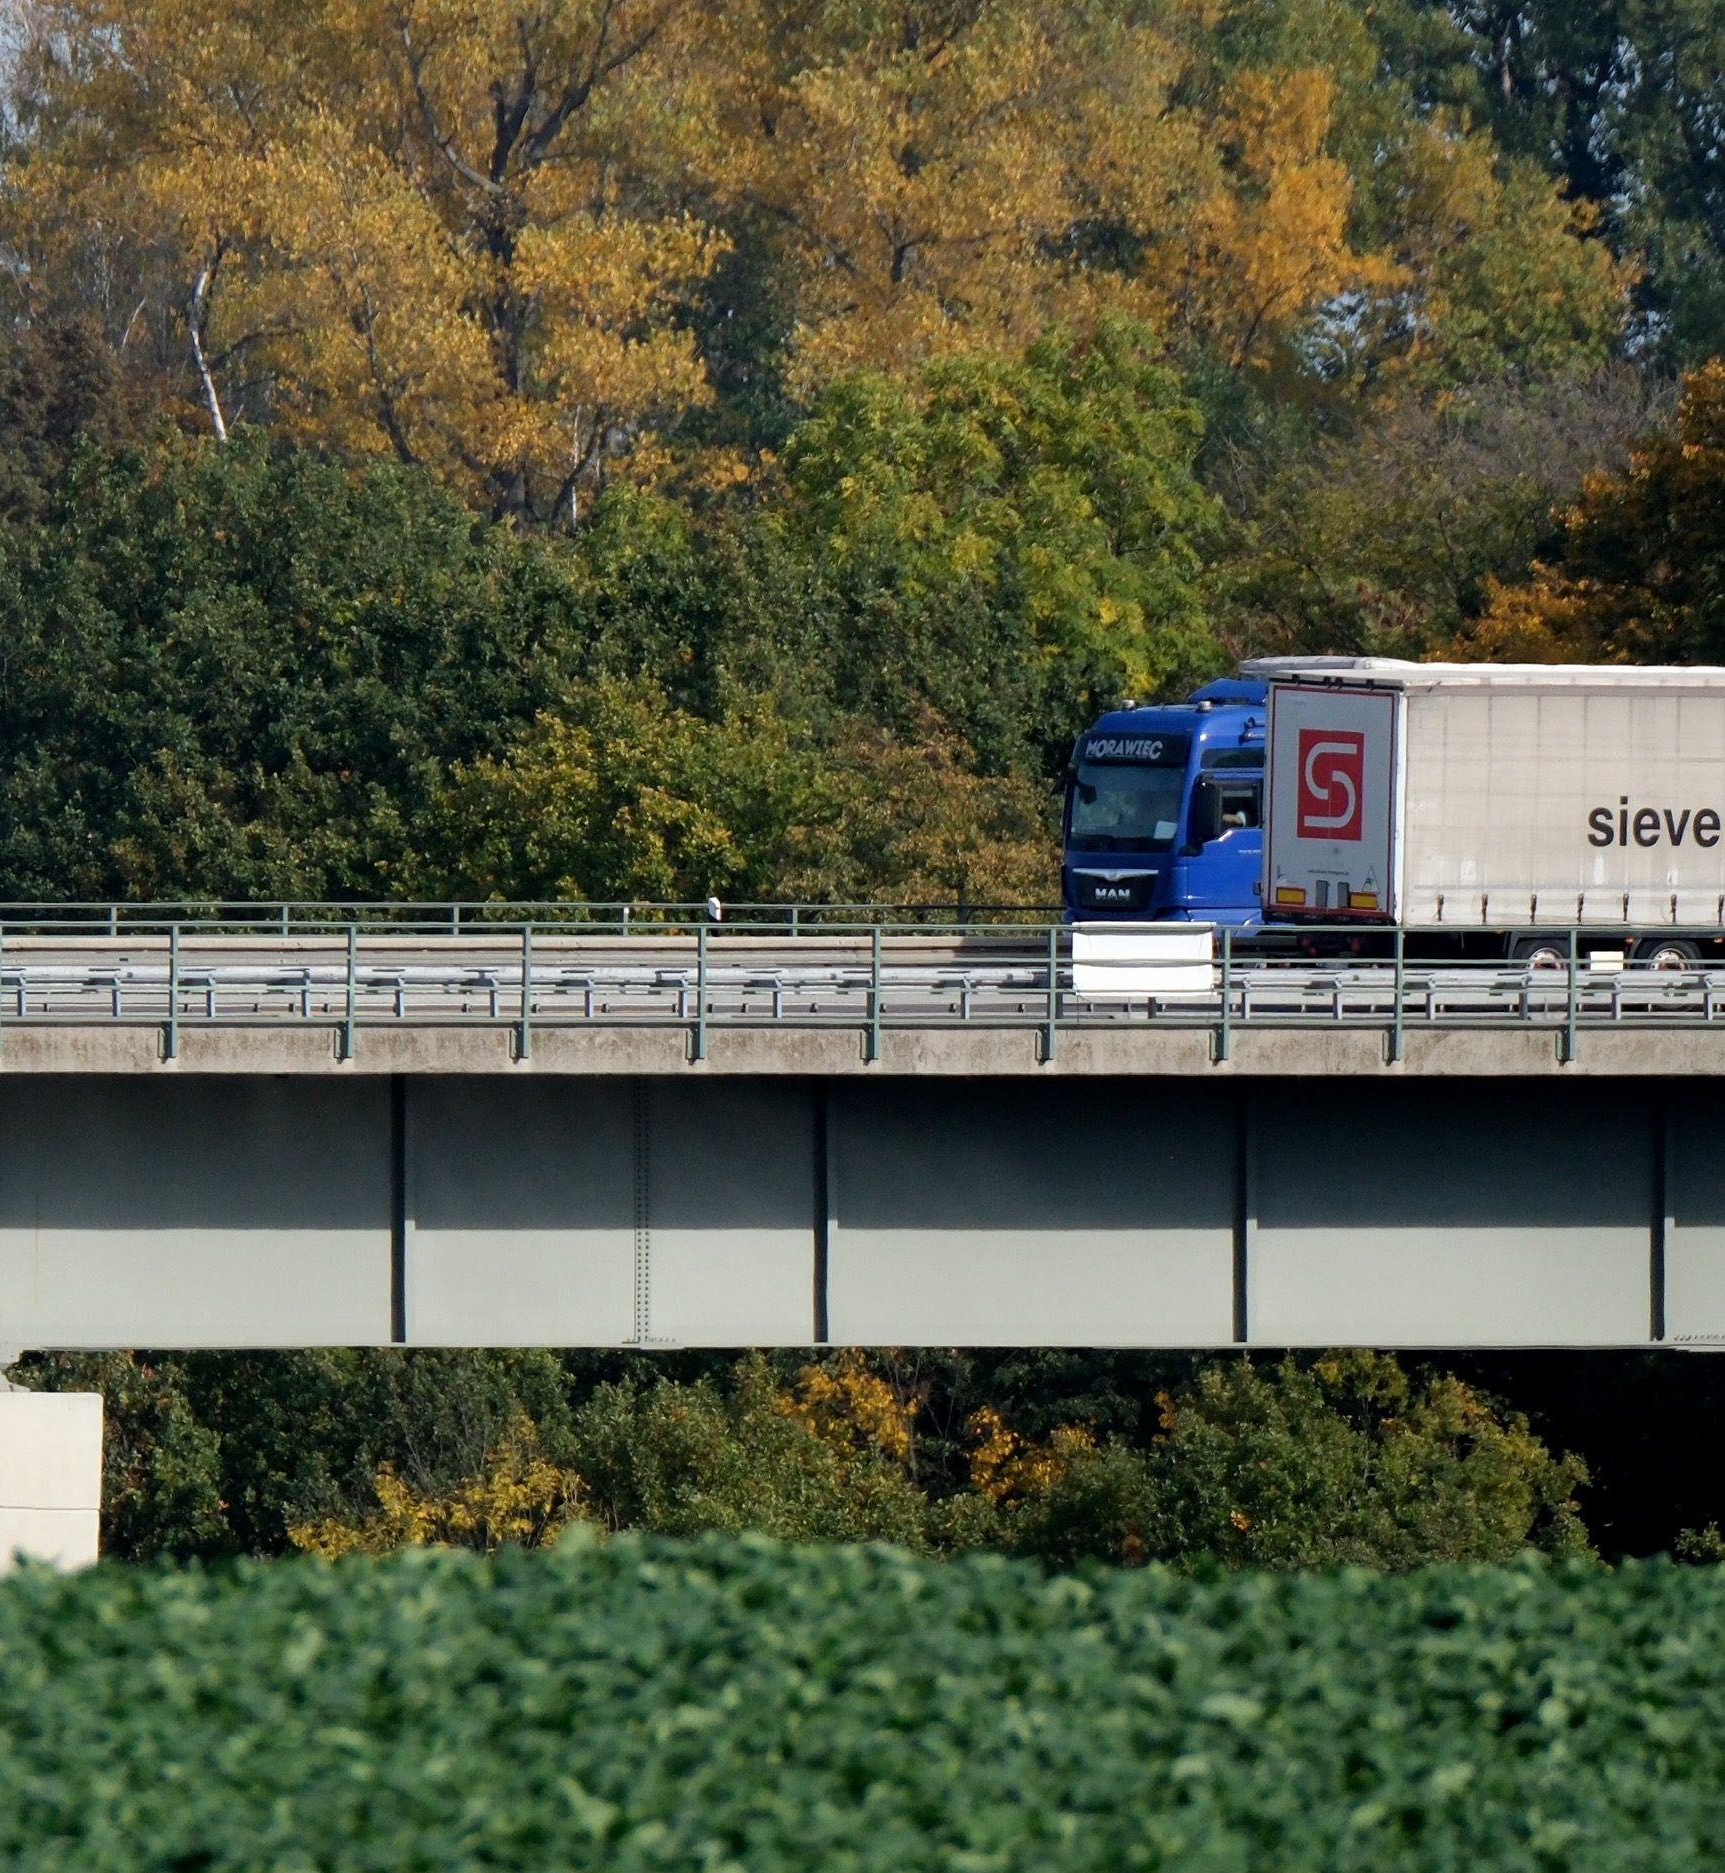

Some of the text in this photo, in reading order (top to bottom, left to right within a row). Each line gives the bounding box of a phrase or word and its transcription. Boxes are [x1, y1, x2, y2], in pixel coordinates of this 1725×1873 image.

[1085, 739, 1163, 759] MORAWIEC
[1587, 795, 1721, 848] sieve
[1095, 887, 1130, 900] MAN
